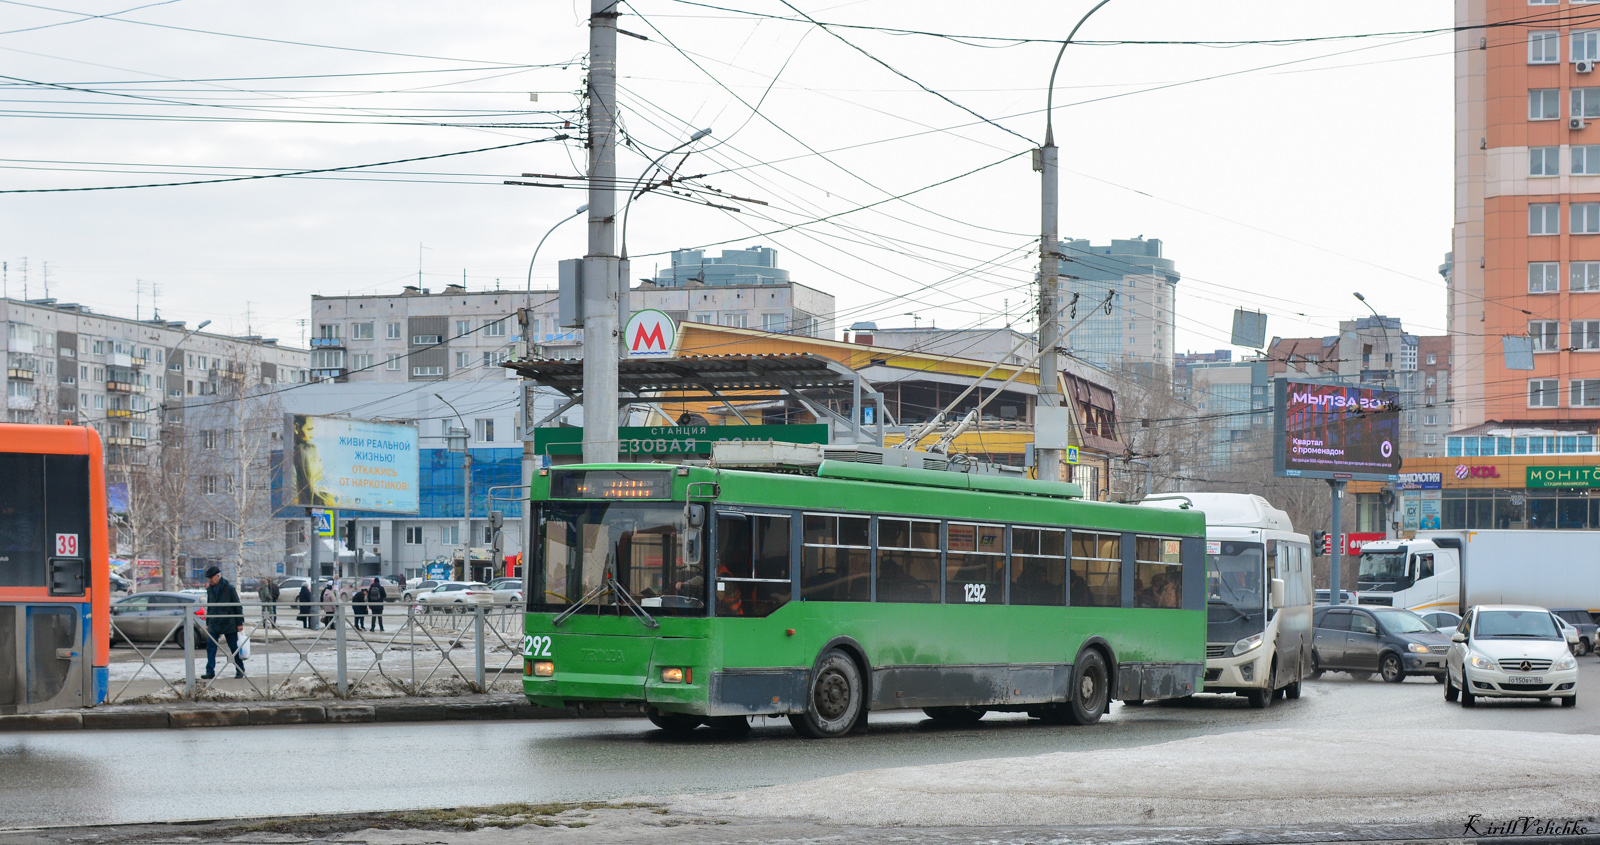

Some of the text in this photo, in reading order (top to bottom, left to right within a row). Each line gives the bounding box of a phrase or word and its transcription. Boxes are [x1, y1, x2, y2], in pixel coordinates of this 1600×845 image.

[632, 322, 666, 351] М
[1293, 392, 1391, 410] МЫЛЗАВО
[651, 427, 707, 436] СТАНЦИЯ
[339, 436, 411, 451] ЖИВИ РЕАЛЬНОЙ
[582, 438, 696, 453] ЕЗОВАЯ
[1293, 438, 1324, 447] Квартал
[354, 451, 396, 463] ЖИЗНЬЮ!
[1299, 447, 1344, 456] променадом
[352, 465, 398, 477] ОТКАЖИСЬ
[1470, 466, 1500, 478] KDL
[339, 477, 410, 491] ОТ НАРКОТИКОВ!
[58, 535, 77, 554] 39
[964, 583, 986, 602] 1292
